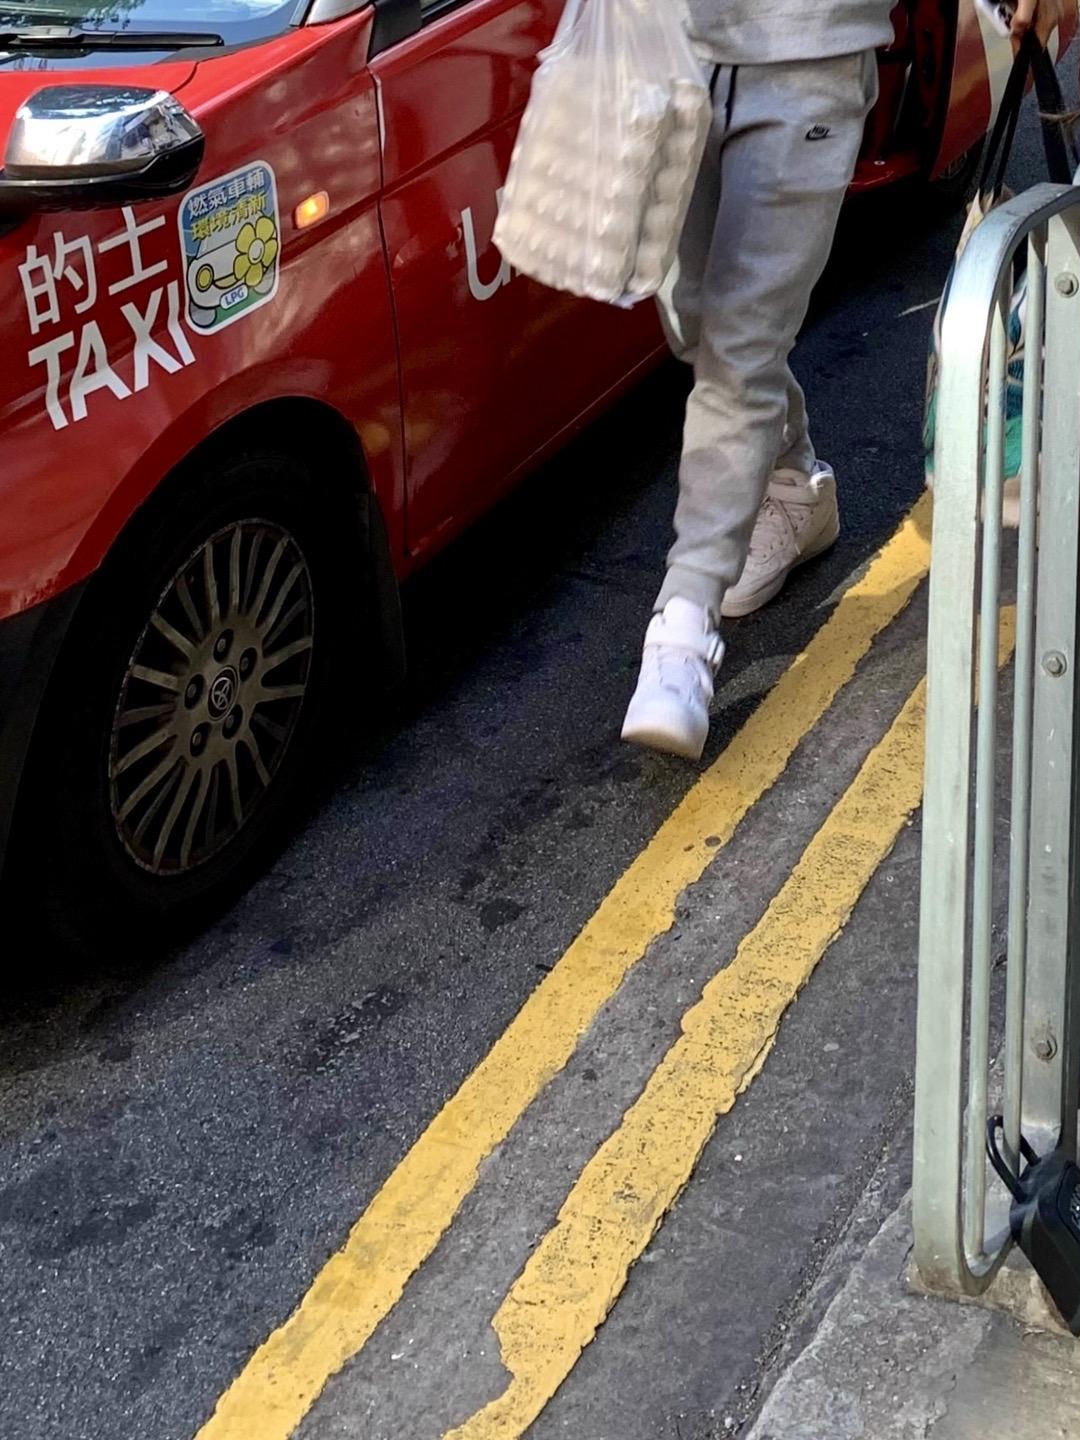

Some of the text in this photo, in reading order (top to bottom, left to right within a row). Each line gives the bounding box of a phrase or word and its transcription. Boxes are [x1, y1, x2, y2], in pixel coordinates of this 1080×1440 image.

[188, 168, 265, 220] 燃氣車輛
[191, 192, 268, 242] 環境清新
[18, 205, 168, 334] 的士
[224, 287, 245, 307] LPG
[28, 280, 196, 431] TAXI
